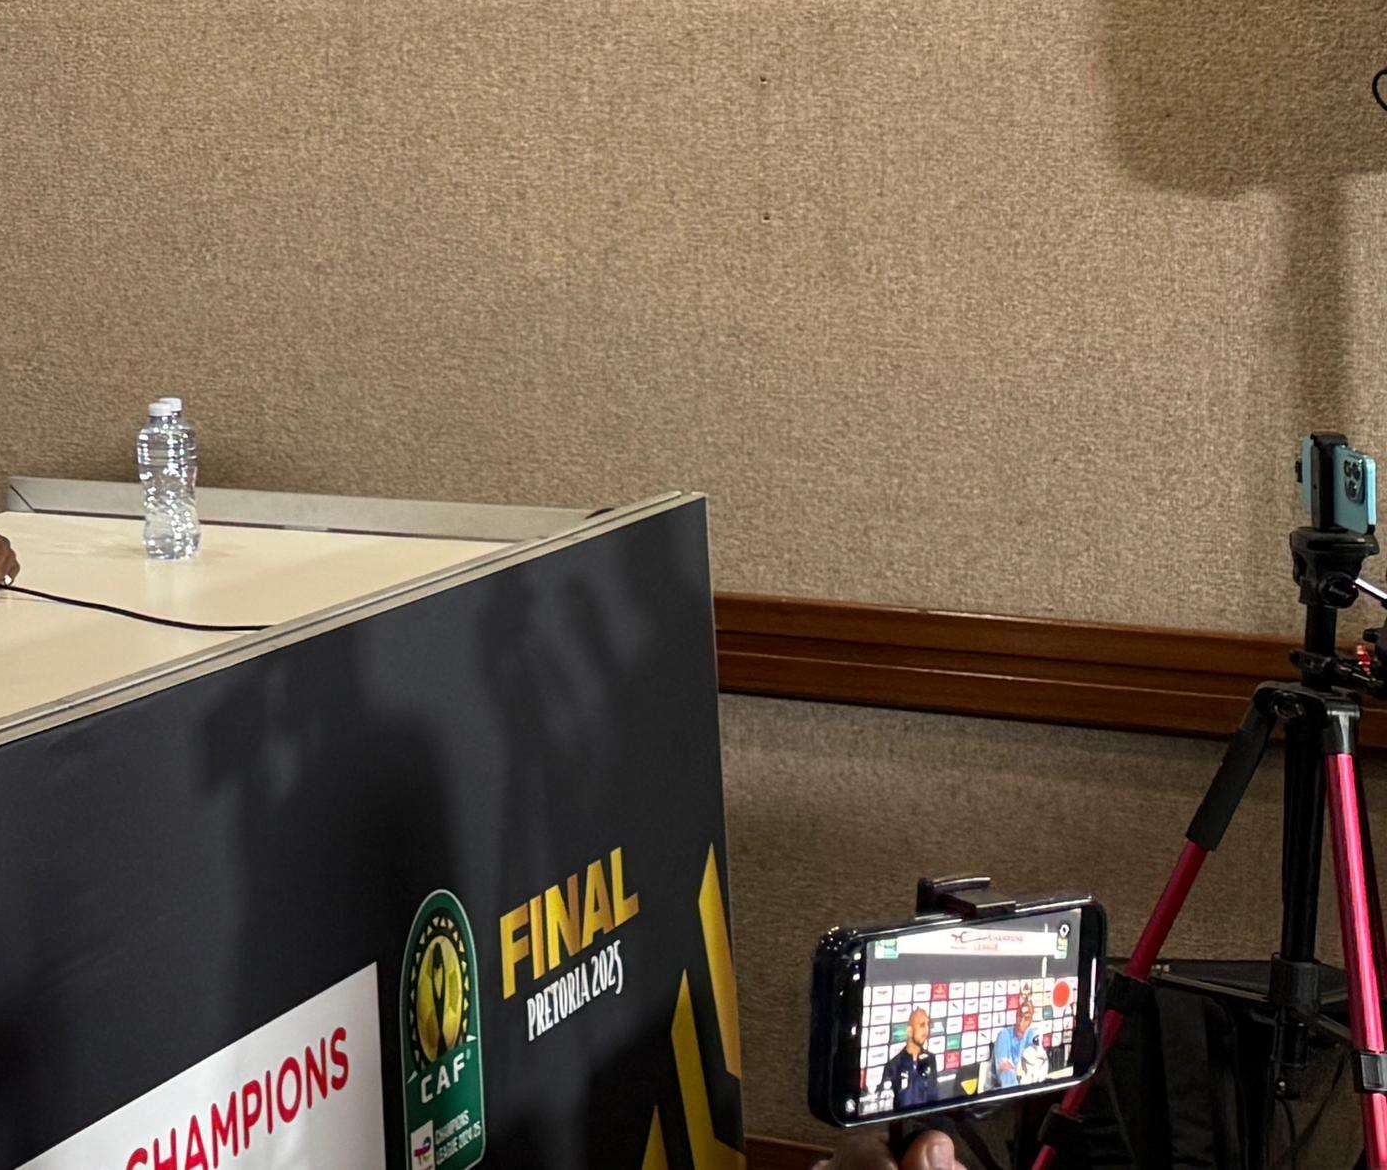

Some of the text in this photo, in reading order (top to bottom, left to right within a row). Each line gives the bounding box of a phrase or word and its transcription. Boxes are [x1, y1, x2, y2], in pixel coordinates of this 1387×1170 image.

[499, 845, 640, 999] FINAL
[526, 938, 624, 1042] PRETORIA 2025
[421, 1052, 466, 1104] CAF
